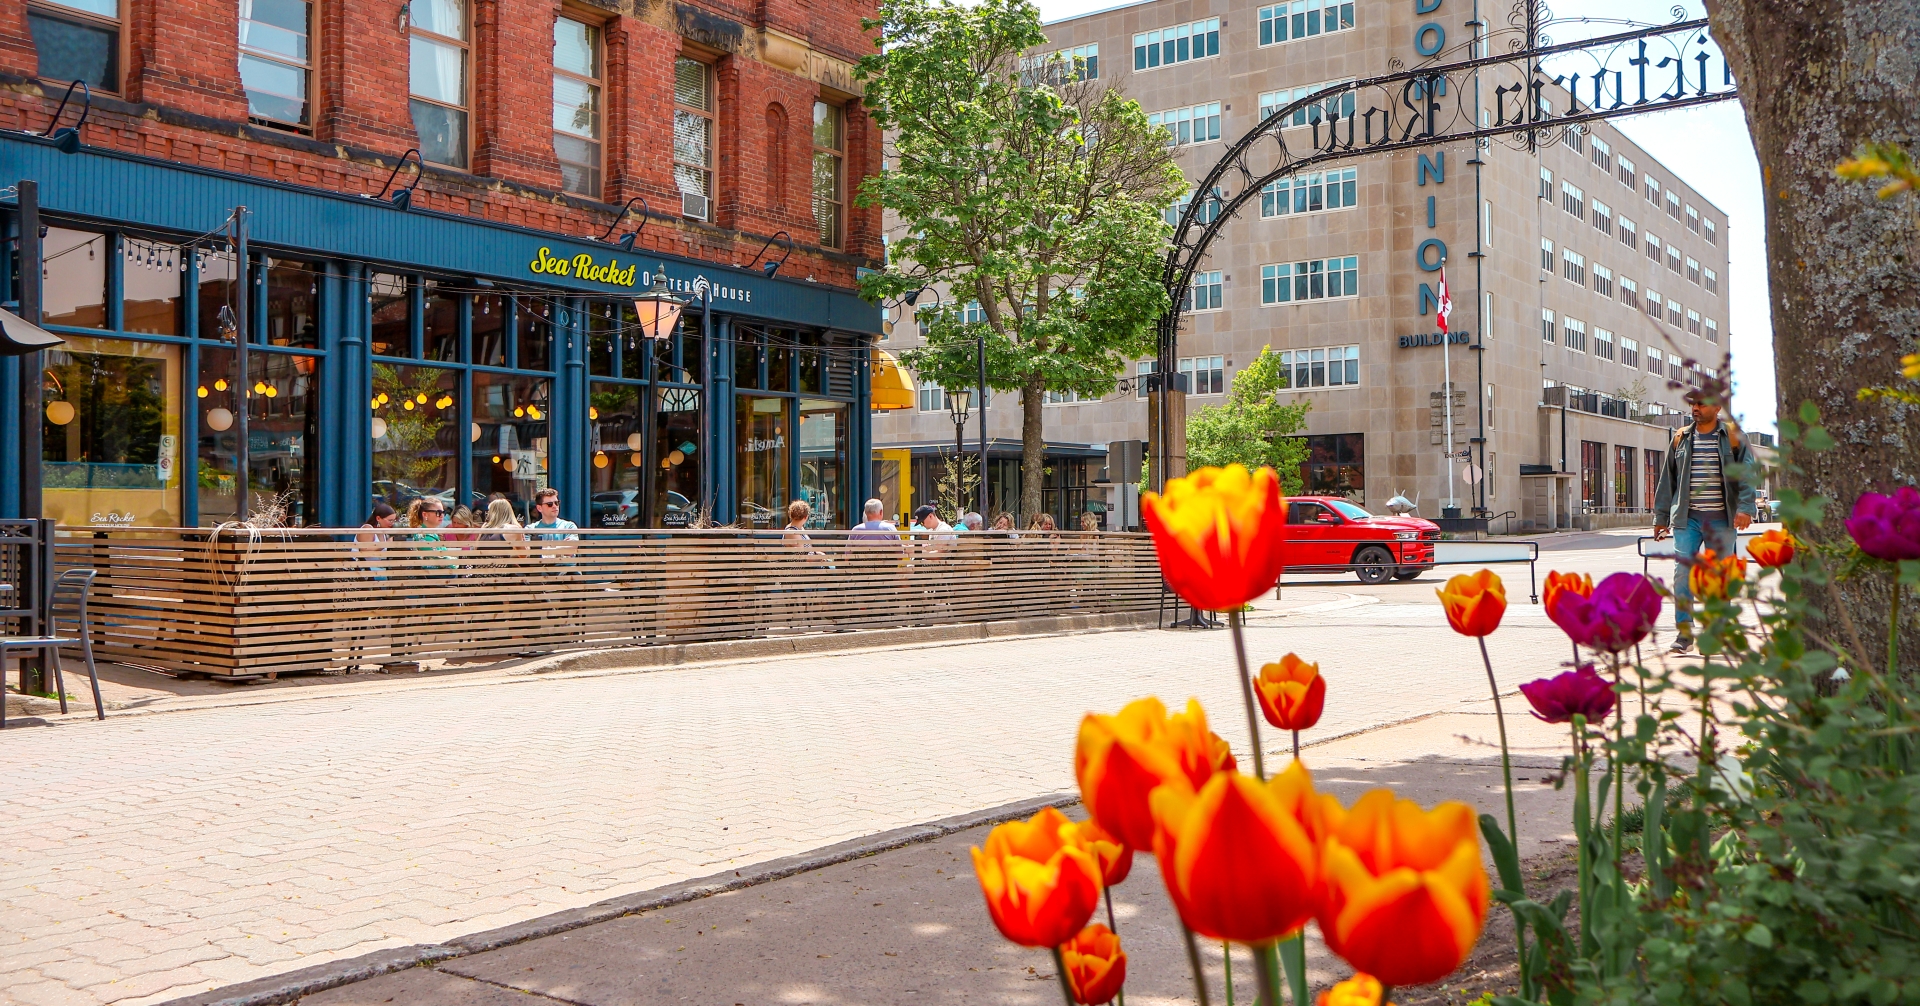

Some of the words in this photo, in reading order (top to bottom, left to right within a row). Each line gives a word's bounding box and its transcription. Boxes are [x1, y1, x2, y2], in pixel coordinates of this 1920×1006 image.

[530, 246, 571, 276] Sea
[572, 254, 636, 287] Rocket
[643, 271, 691, 292] OTER
[713, 282, 751, 302] HOUSE
[91, 512, 108, 522] Sea
[108, 512, 136, 522] Rocket
[602, 513, 612, 522] Sea
[612, 513, 628, 522] Rocket
[663, 513, 672, 522] Sea
[672, 513, 687, 522] Rocket
